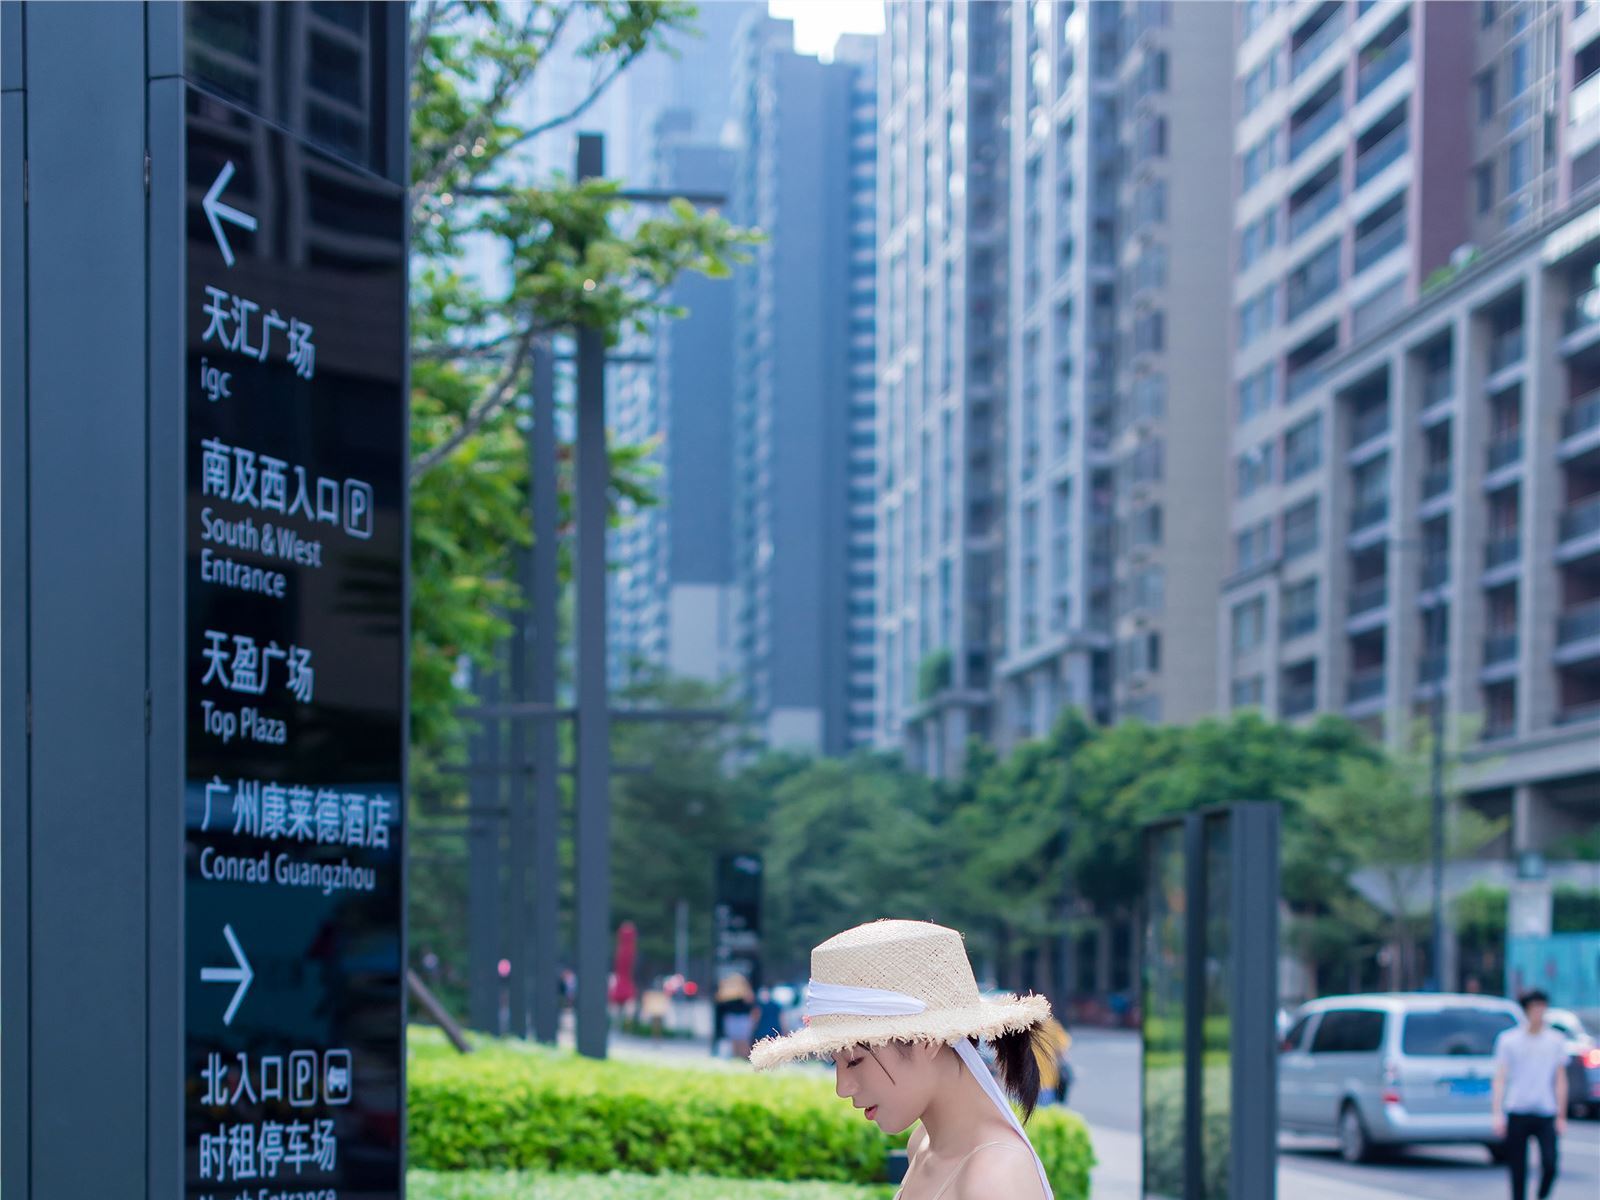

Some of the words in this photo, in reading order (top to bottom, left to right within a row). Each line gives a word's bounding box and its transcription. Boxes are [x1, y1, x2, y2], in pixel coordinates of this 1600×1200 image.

[202, 284, 316, 380] 天汇广场
[201, 356, 232, 401] igc
[201, 437, 339, 526] 南及西入口
[201, 506, 259, 551] South
[276, 526, 322, 568] West
[201, 548, 287, 599] Entrance
[202, 629, 314, 703] 天盈广场
[201, 700, 237, 745] Top
[240, 706, 287, 746] Plaza
[201, 775, 391, 850] 广州康莱德酒店
[200, 846, 270, 883] Conrad
[274, 852, 376, 896] Guangzhou
[200, 1052, 282, 1105] 北入口
[200, 1118, 337, 1182] 时租停车场
